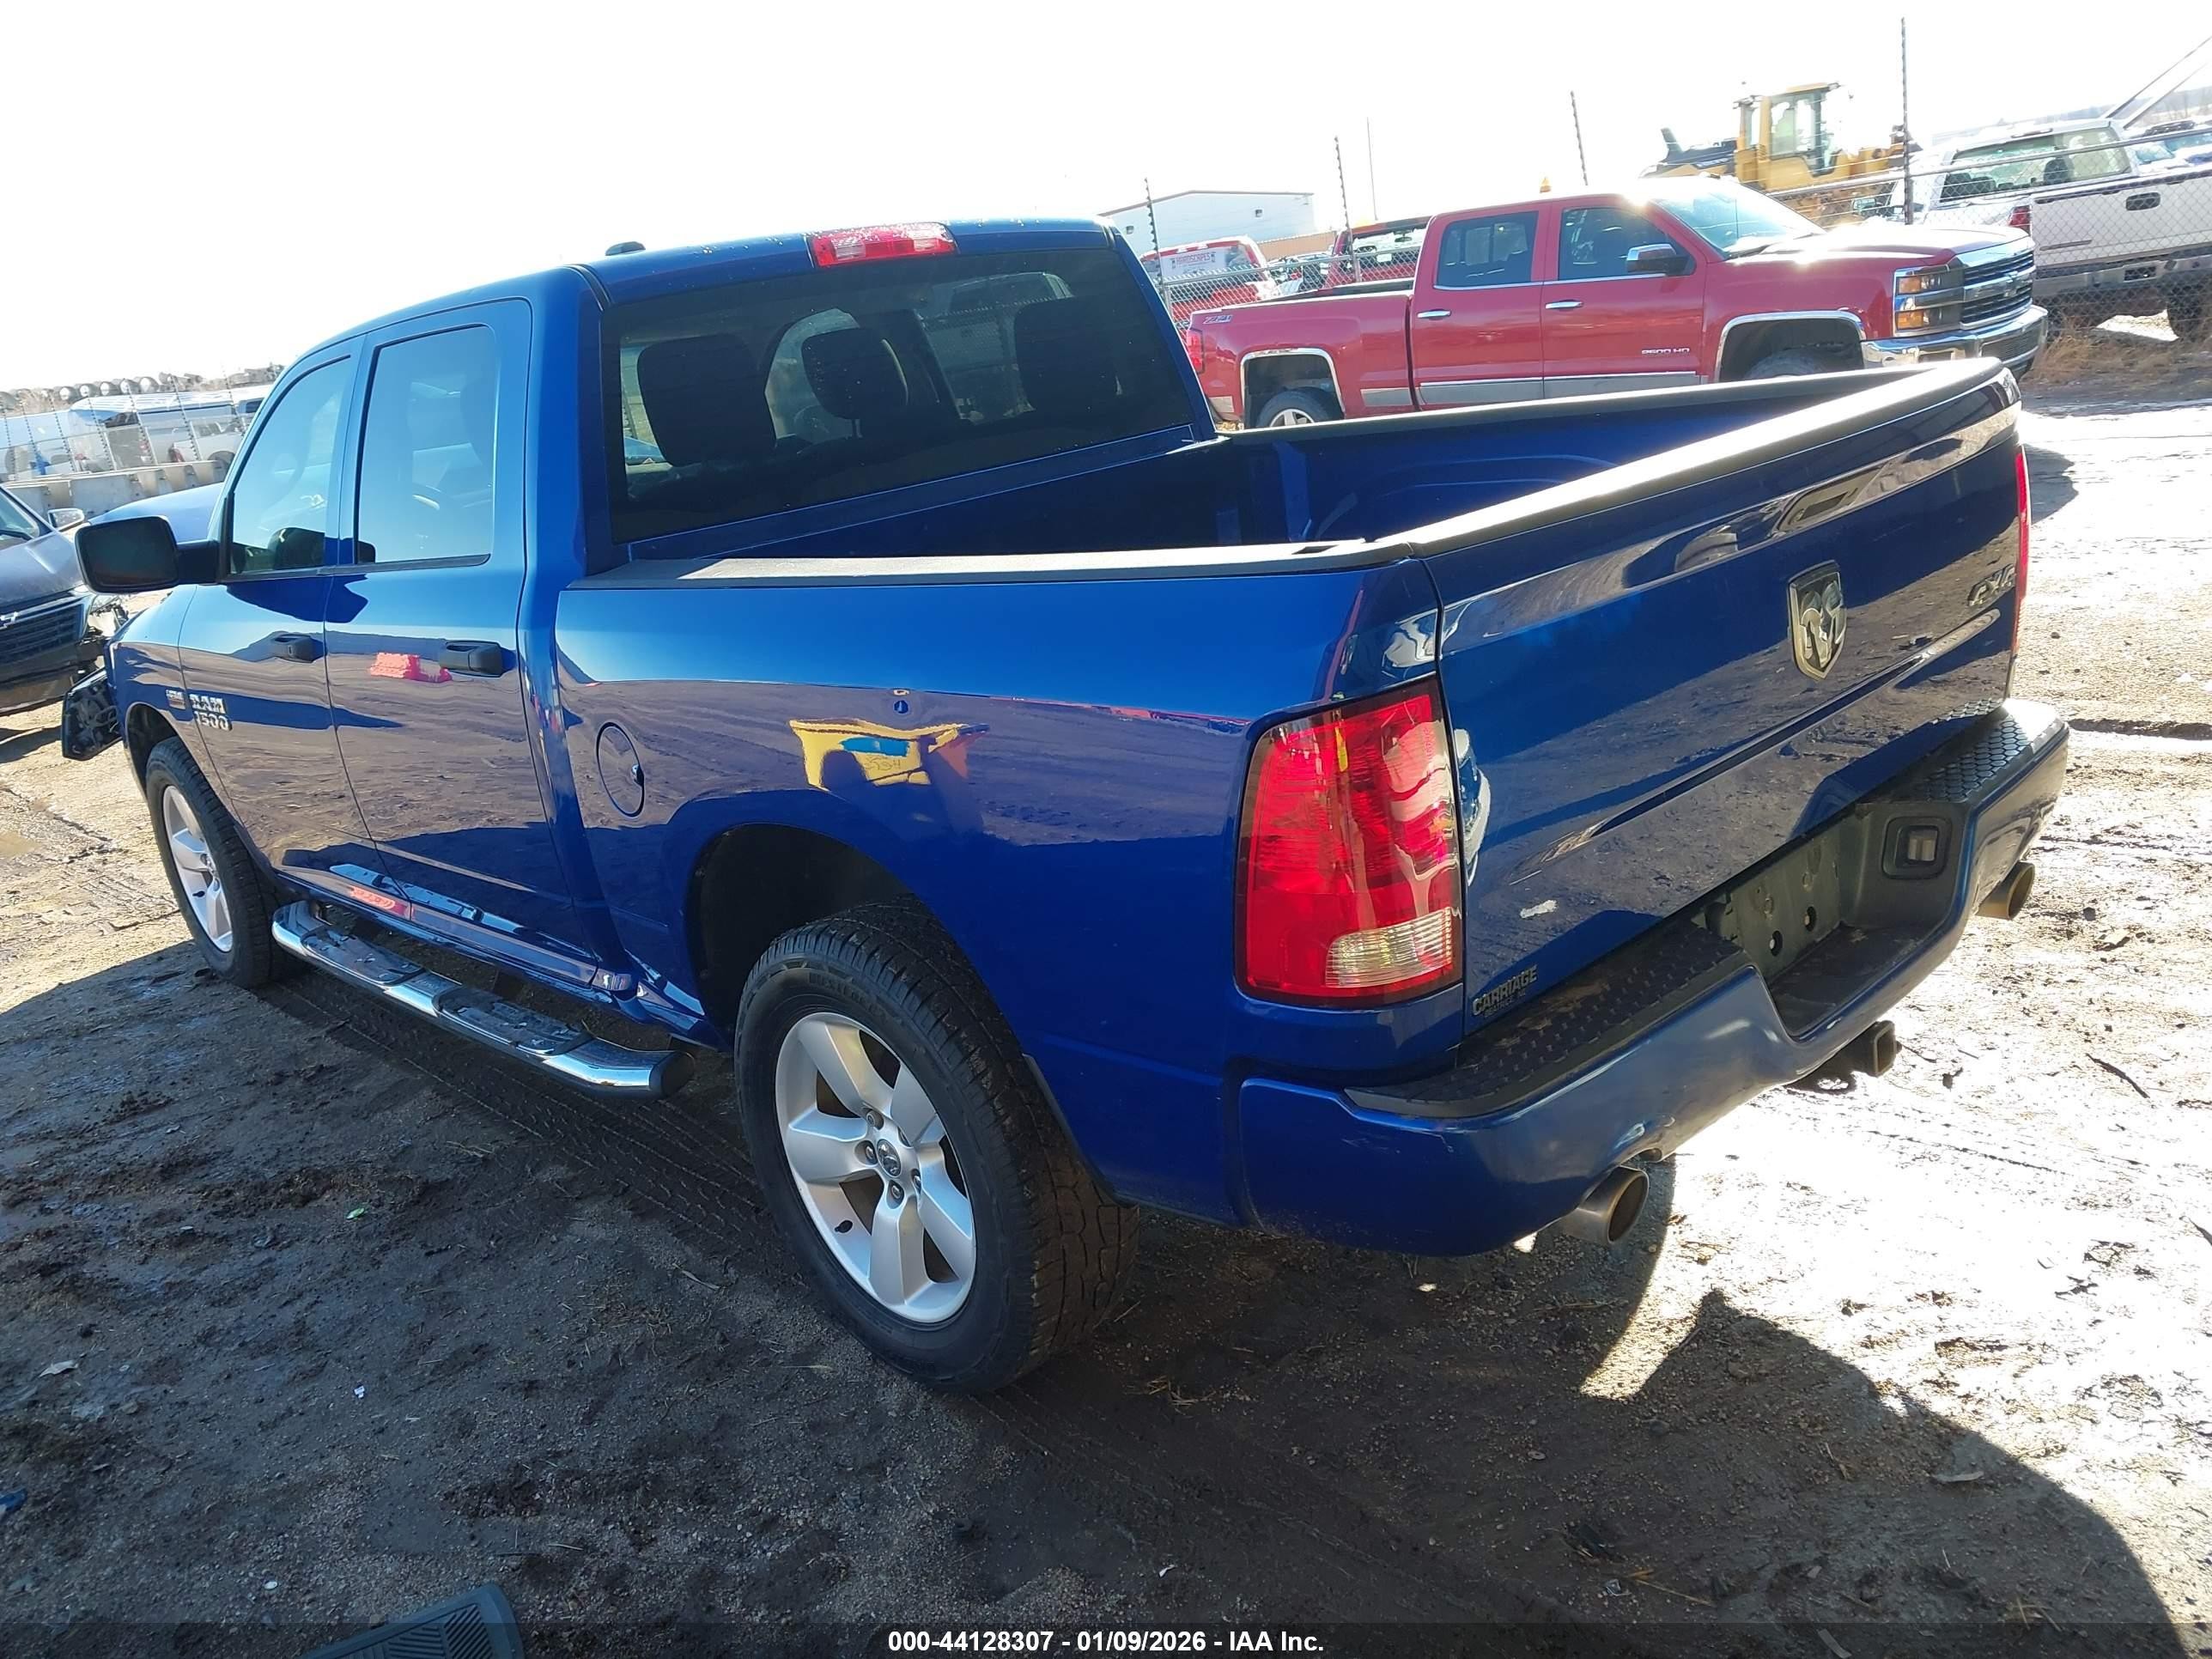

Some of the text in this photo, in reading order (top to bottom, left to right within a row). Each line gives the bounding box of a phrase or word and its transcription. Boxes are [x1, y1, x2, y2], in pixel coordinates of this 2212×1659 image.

[188, 693, 227, 714] RAM
[194, 710, 232, 732] 1500
[1472, 963, 1538, 1017] CARRIAGE
